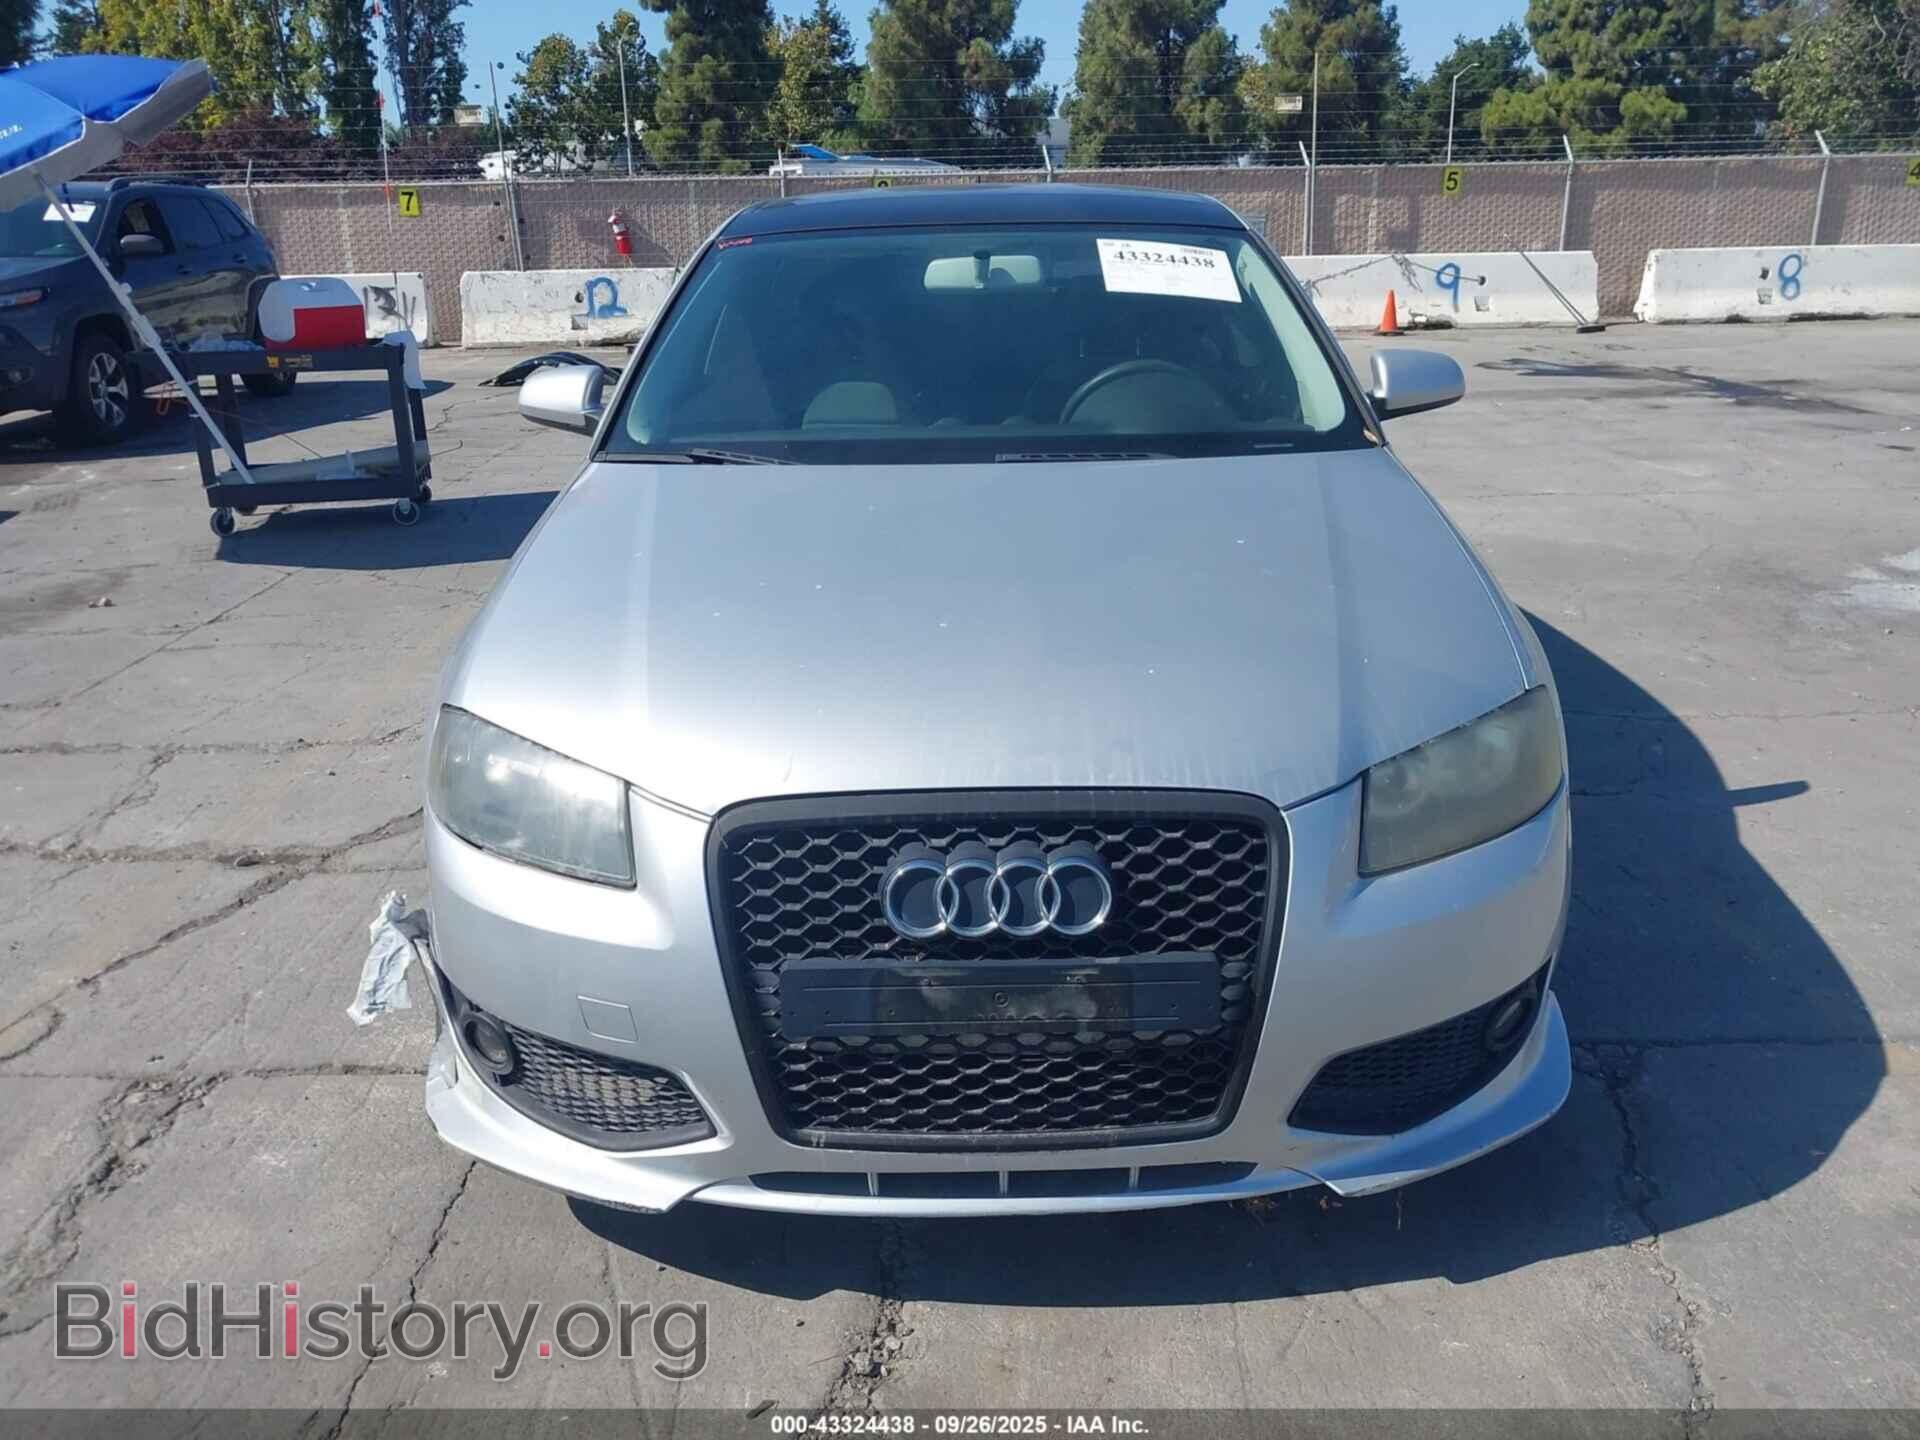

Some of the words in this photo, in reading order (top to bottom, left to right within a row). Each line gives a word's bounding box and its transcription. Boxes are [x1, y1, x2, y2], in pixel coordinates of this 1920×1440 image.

[1445, 171, 1459, 191] 5
[400, 191, 414, 212] 7
[1113, 250, 1216, 269] 43324438
[1436, 262, 1460, 312] 9
[1778, 253, 1802, 300] 8
